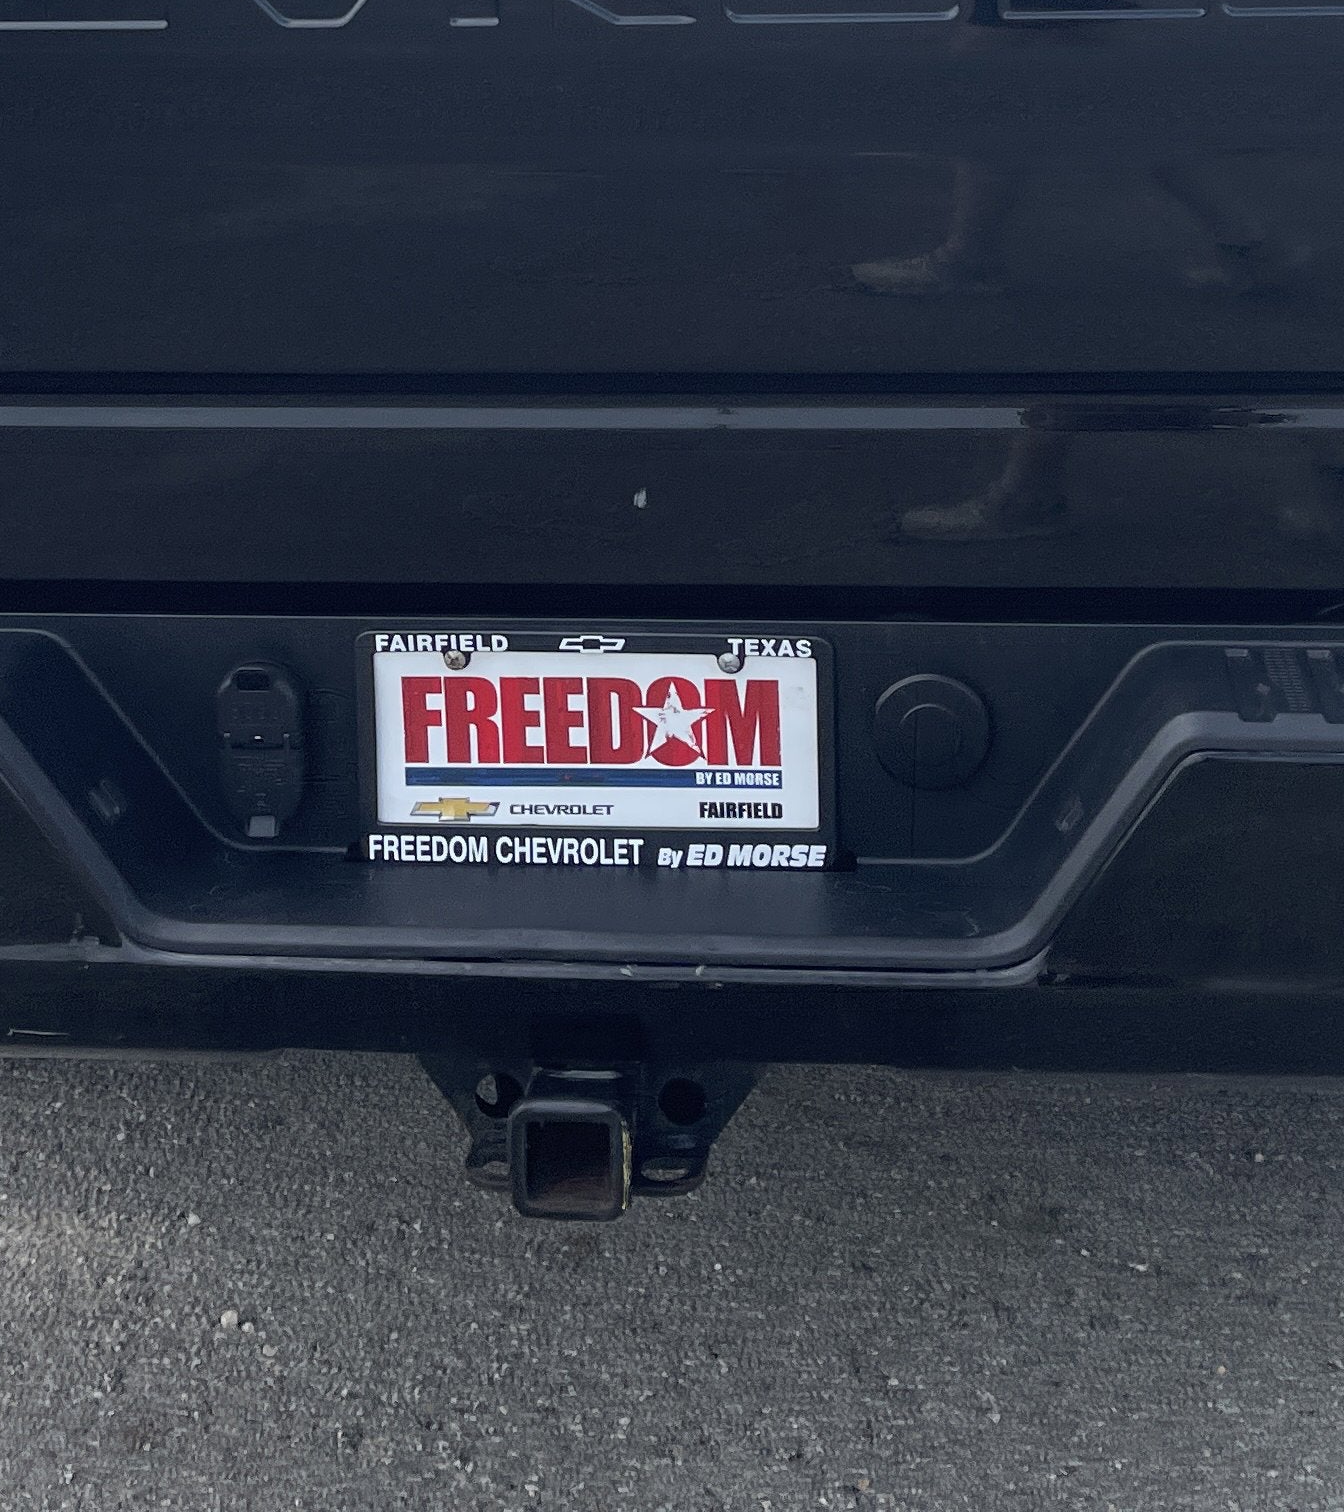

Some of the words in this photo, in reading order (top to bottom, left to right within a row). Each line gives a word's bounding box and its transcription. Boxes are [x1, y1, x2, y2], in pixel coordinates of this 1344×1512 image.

[374, 633, 509, 654] FAIRFIELD
[727, 638, 813, 657] TEXAS
[401, 676, 782, 767] FREEDOM
[695, 771, 712, 786] BY
[715, 771, 731, 786] ED
[734, 772, 780, 787] MORSE
[509, 803, 614, 816] CHEVROLET
[699, 802, 783, 819] FAIRFIELD
[368, 834, 489, 863] FREEDOM
[494, 836, 644, 866] CHEVROLET
[657, 846, 683, 869] By
[686, 844, 722, 867] ED
[727, 844, 827, 867] MORSE
